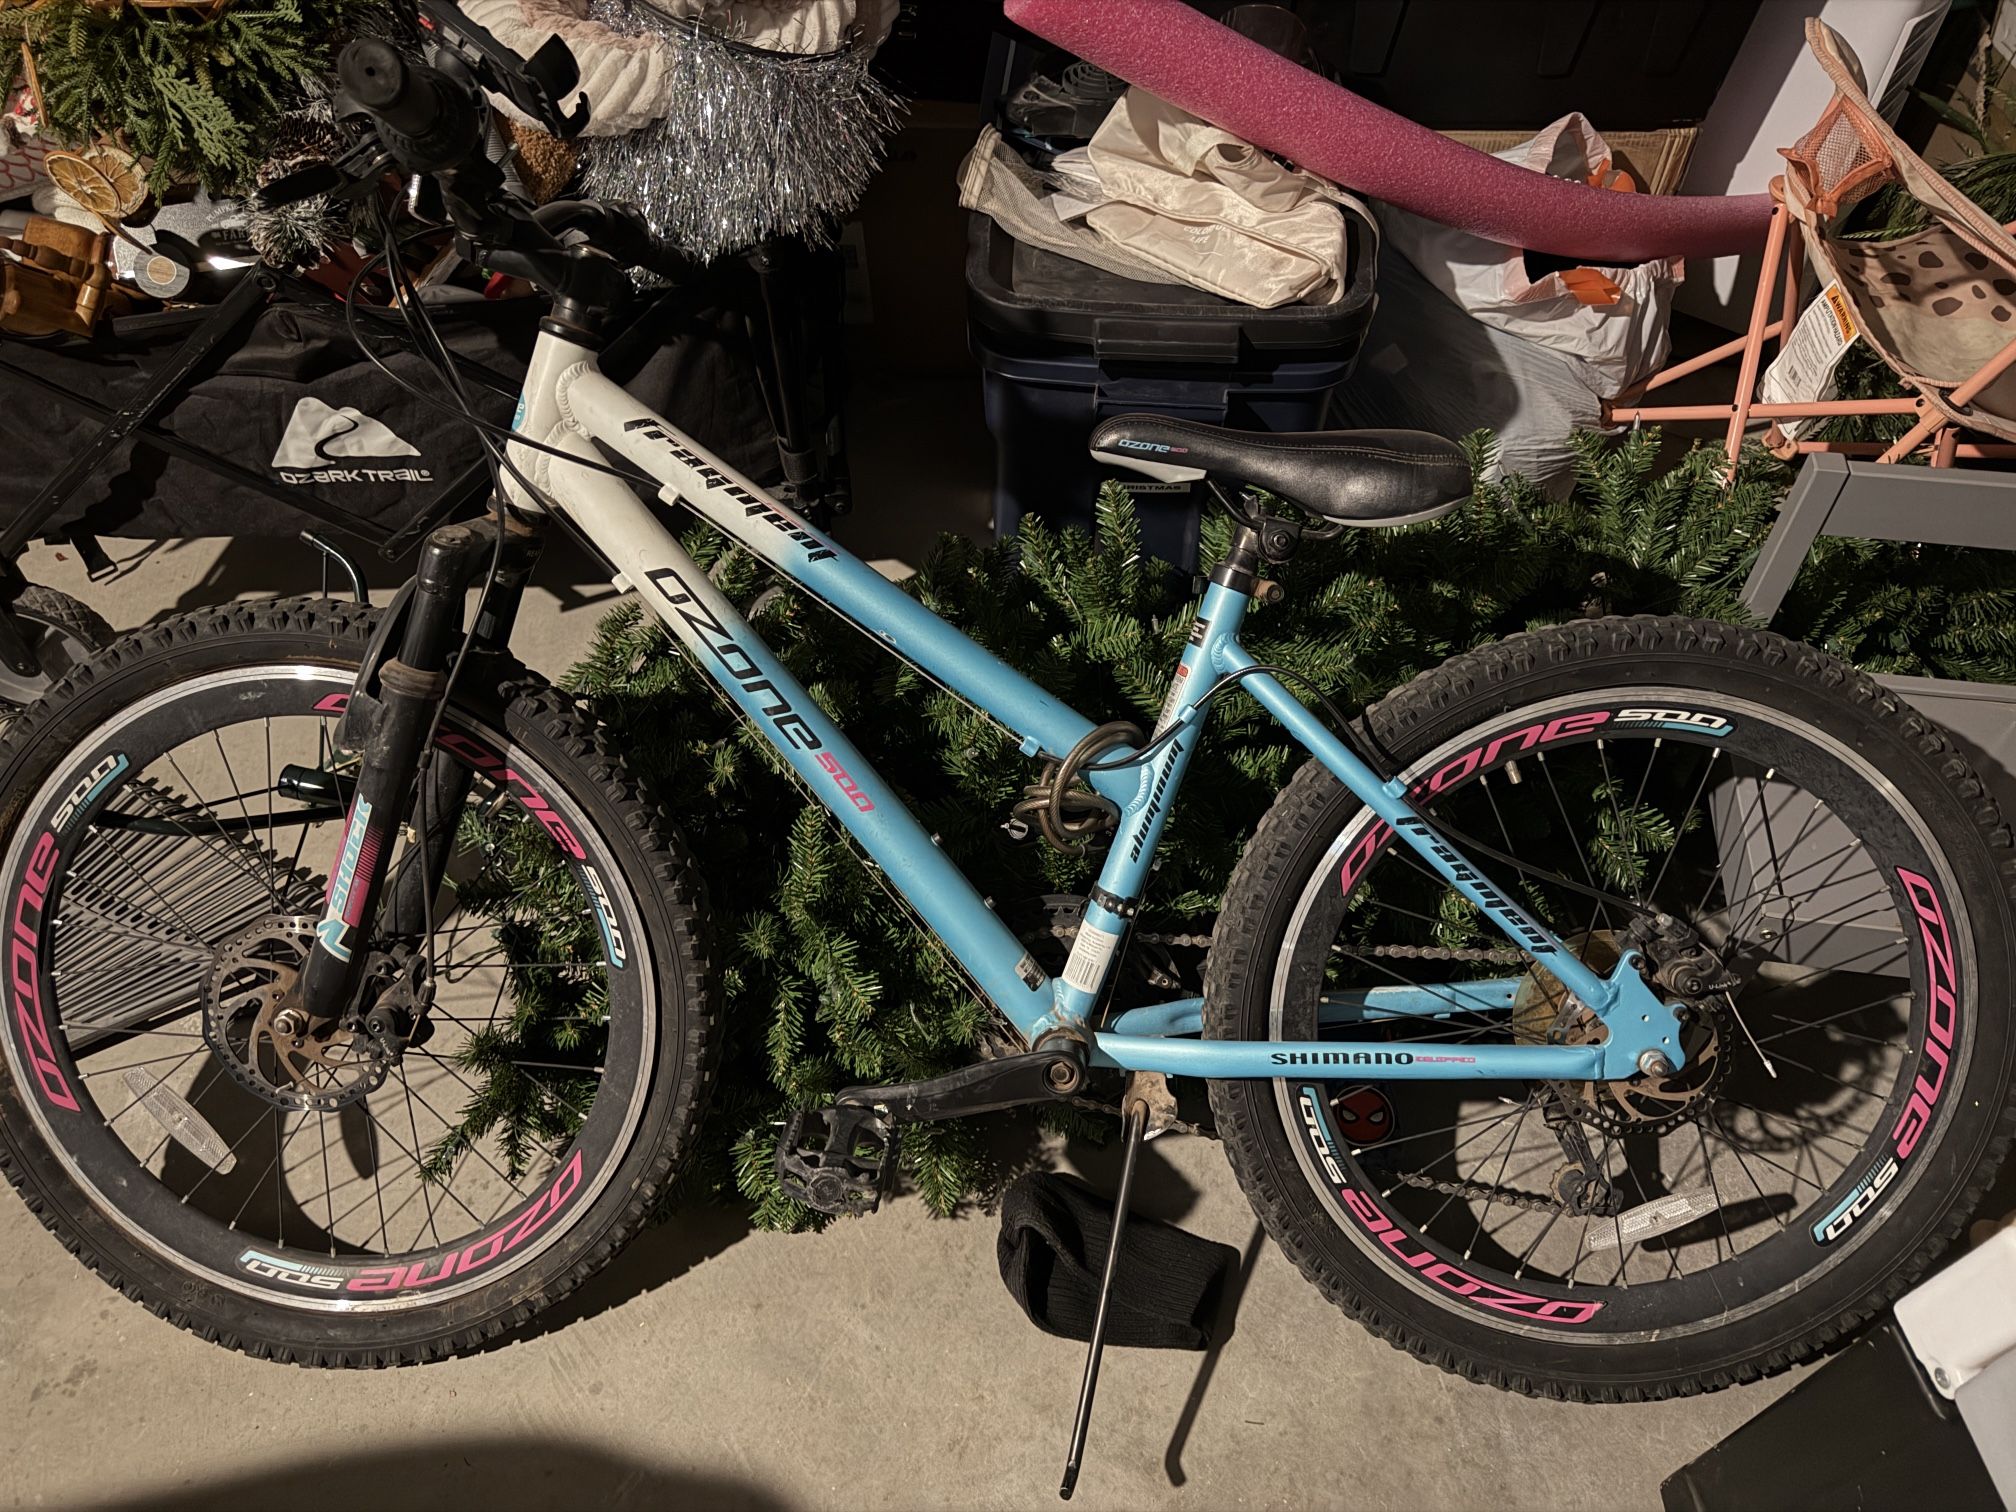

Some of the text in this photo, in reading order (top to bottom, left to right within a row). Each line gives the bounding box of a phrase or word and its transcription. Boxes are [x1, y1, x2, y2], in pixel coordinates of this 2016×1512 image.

[1834, 301, 1852, 334] WARNING
[624, 418, 838, 563] fragment
[1613, 708, 1727, 730] 500
[50, 755, 118, 833] 500
[815, 751, 875, 813] 500
[1129, 738, 1184, 864] aluminum
[331, 794, 372, 914] SHOCK
[1395, 816, 1559, 958] fragment
[581, 864, 627, 961] 500
[1271, 1052, 1414, 1065] SHIMANO
[1300, 1096, 1347, 1184] 500
[1826, 1156, 1899, 1242] 500
[245, 1259, 345, 1290] 500
